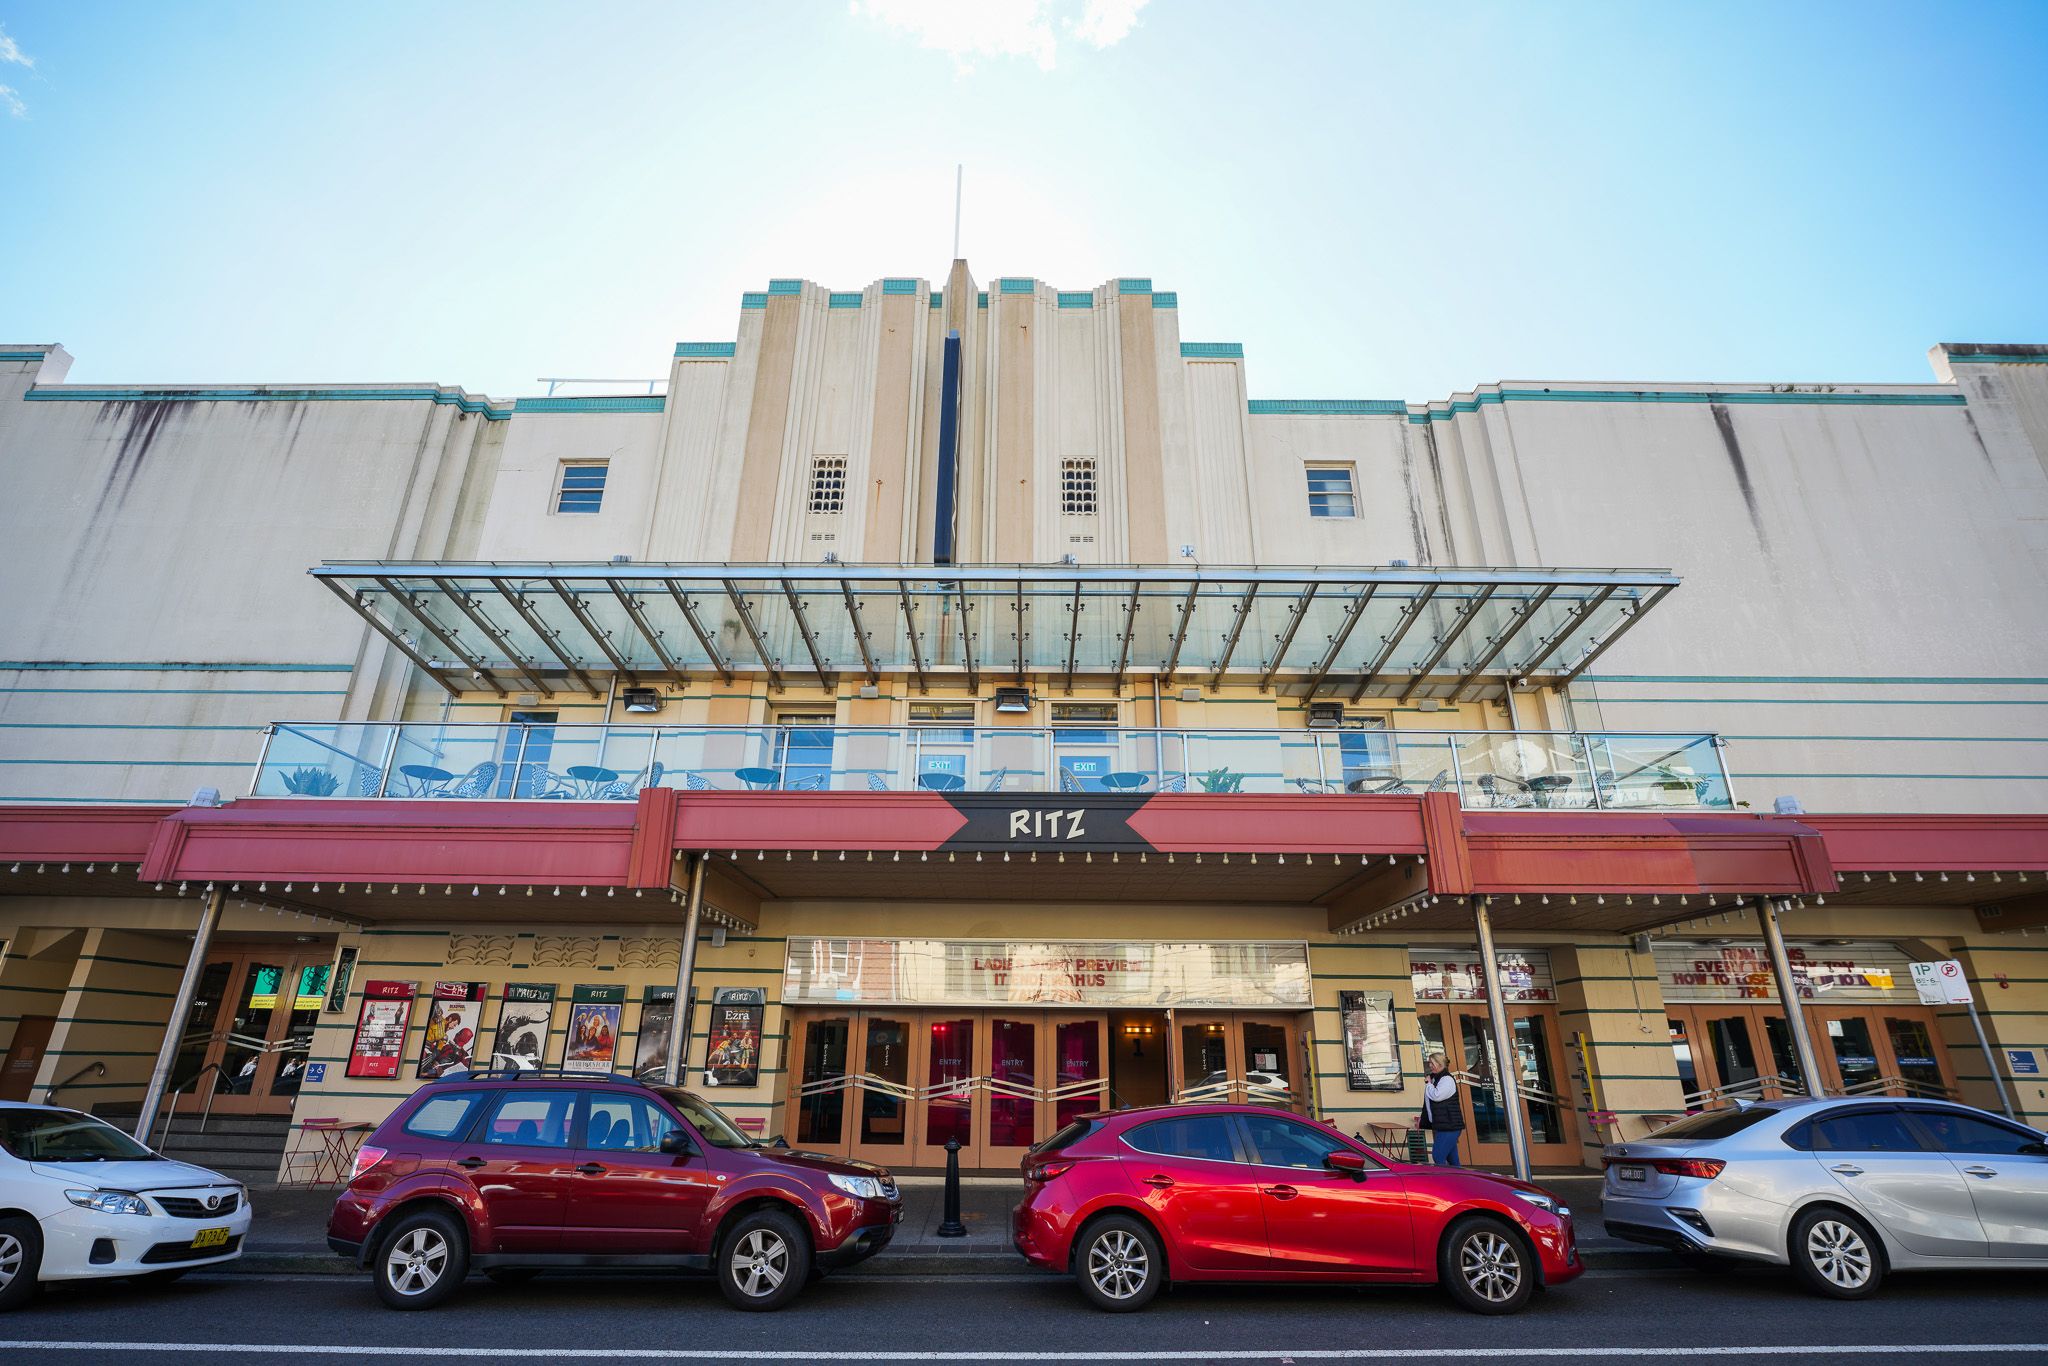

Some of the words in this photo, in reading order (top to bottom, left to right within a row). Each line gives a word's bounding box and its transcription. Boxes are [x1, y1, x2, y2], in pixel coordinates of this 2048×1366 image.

[929, 761, 951, 769] EXIT
[1074, 762, 1096, 771] EXIT
[1010, 808, 1085, 839] RITZ
[1915, 964, 1931, 975] 1P
[335, 962, 347, 996] RITZ
[993, 973, 1007, 986] IT
[1087, 974, 1106, 986] US
[1672, 973, 1707, 985] HOW
[1711, 973, 1730, 985] TO
[1735, 973, 1771, 985] LOSE
[382, 986, 399, 994] RITZ
[590, 990, 609, 998] RITZ
[661, 991, 676, 999] RIT
[725, 1010, 750, 1020] Ezra
